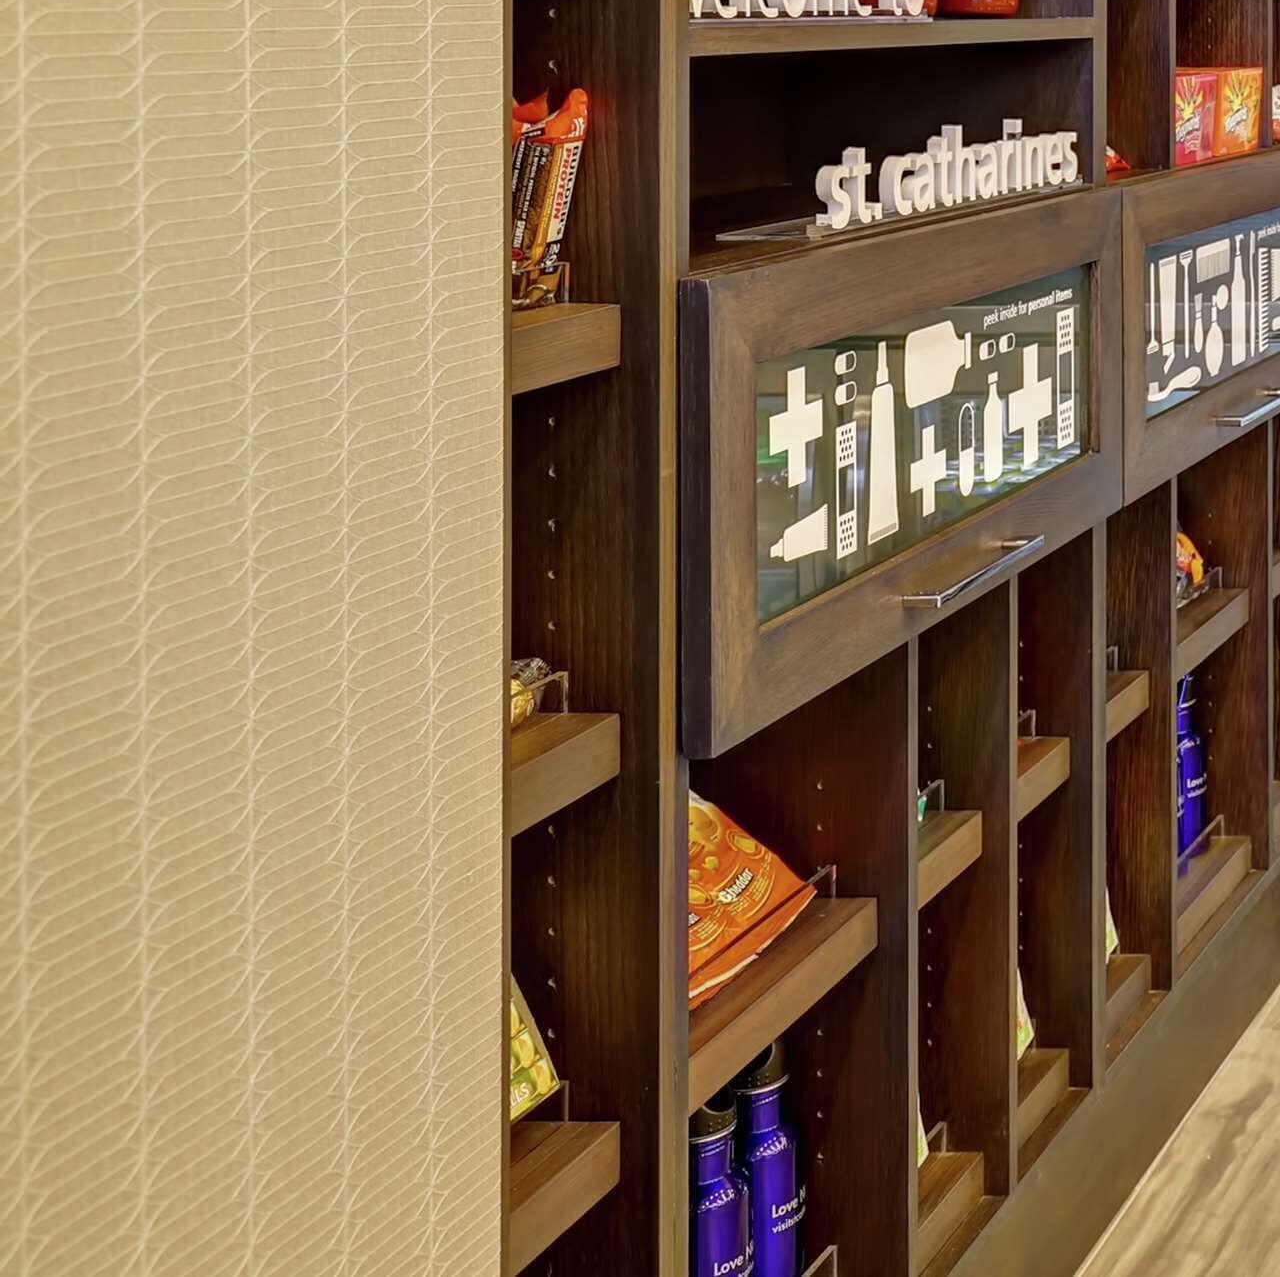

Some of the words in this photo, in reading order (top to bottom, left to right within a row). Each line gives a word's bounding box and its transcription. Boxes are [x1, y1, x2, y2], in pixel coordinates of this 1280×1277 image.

[553, 146, 573, 220] PROTEIN
[878, 118, 1080, 216] catharines
[983, 308, 999, 331] peek
[999, 303, 1018, 322] inside
[1018, 299, 1028, 316] for
[1027, 290, 1056, 316] personal
[1055, 287, 1073, 303] items
[771, 1197, 799, 1219] Love
[713, 1255, 744, 1277] Love
